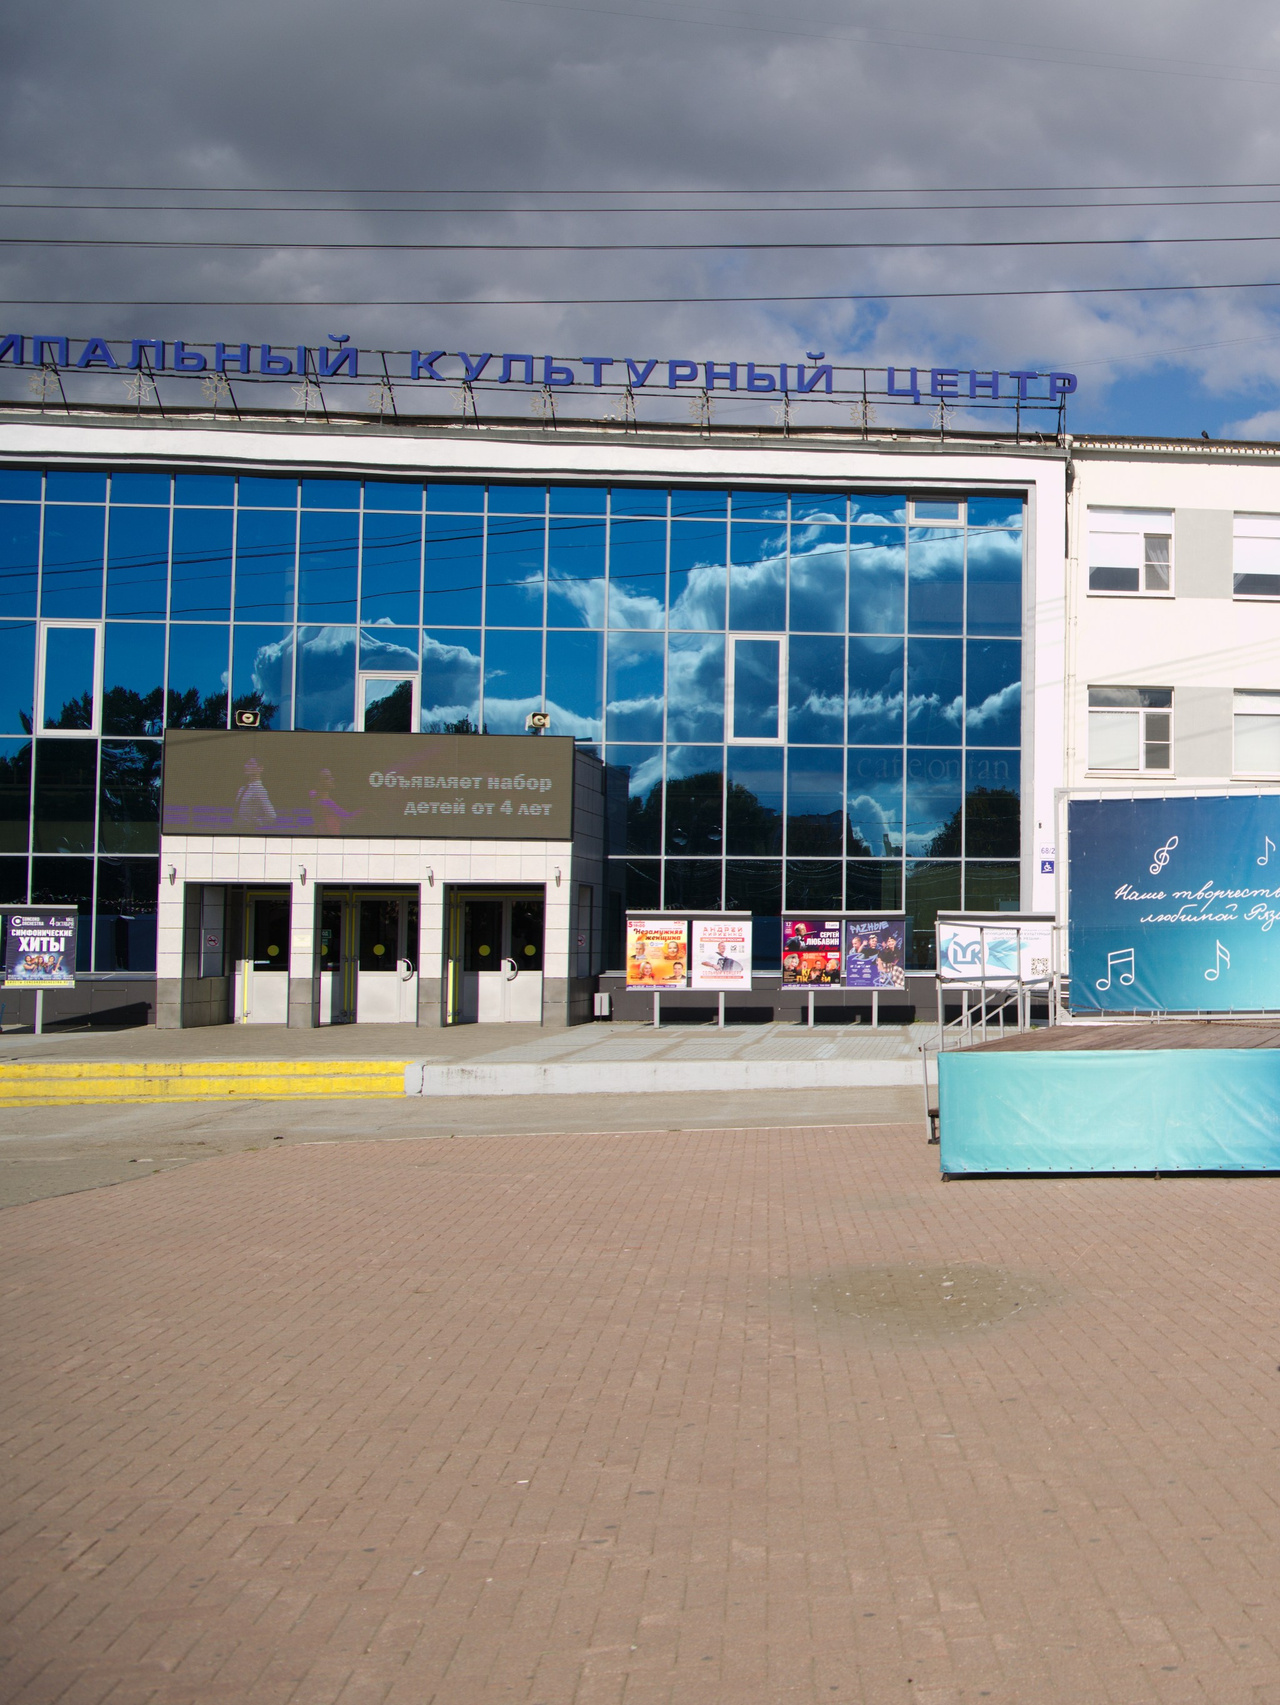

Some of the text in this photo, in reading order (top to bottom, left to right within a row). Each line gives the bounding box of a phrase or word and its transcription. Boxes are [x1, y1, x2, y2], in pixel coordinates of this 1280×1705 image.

[411, 350, 834, 395] КУЛЬТУРНЫЙ
[887, 366, 1078, 404] ЦЕНТР
[369, 771, 553, 793] Объявляет набор
[404, 798, 553, 815] детей от 4 лет
[1114, 883, 1167, 900] Наше
[1140, 903, 1238, 923] любимой
[11, 929, 73, 937] СИМФОНИЧЕСКИЕ
[806, 937, 839, 946] ЛЮБАВИН
[820, 930, 839, 938] СЕРГЕЙ
[18, 937, 65, 952] ХИТЫ
